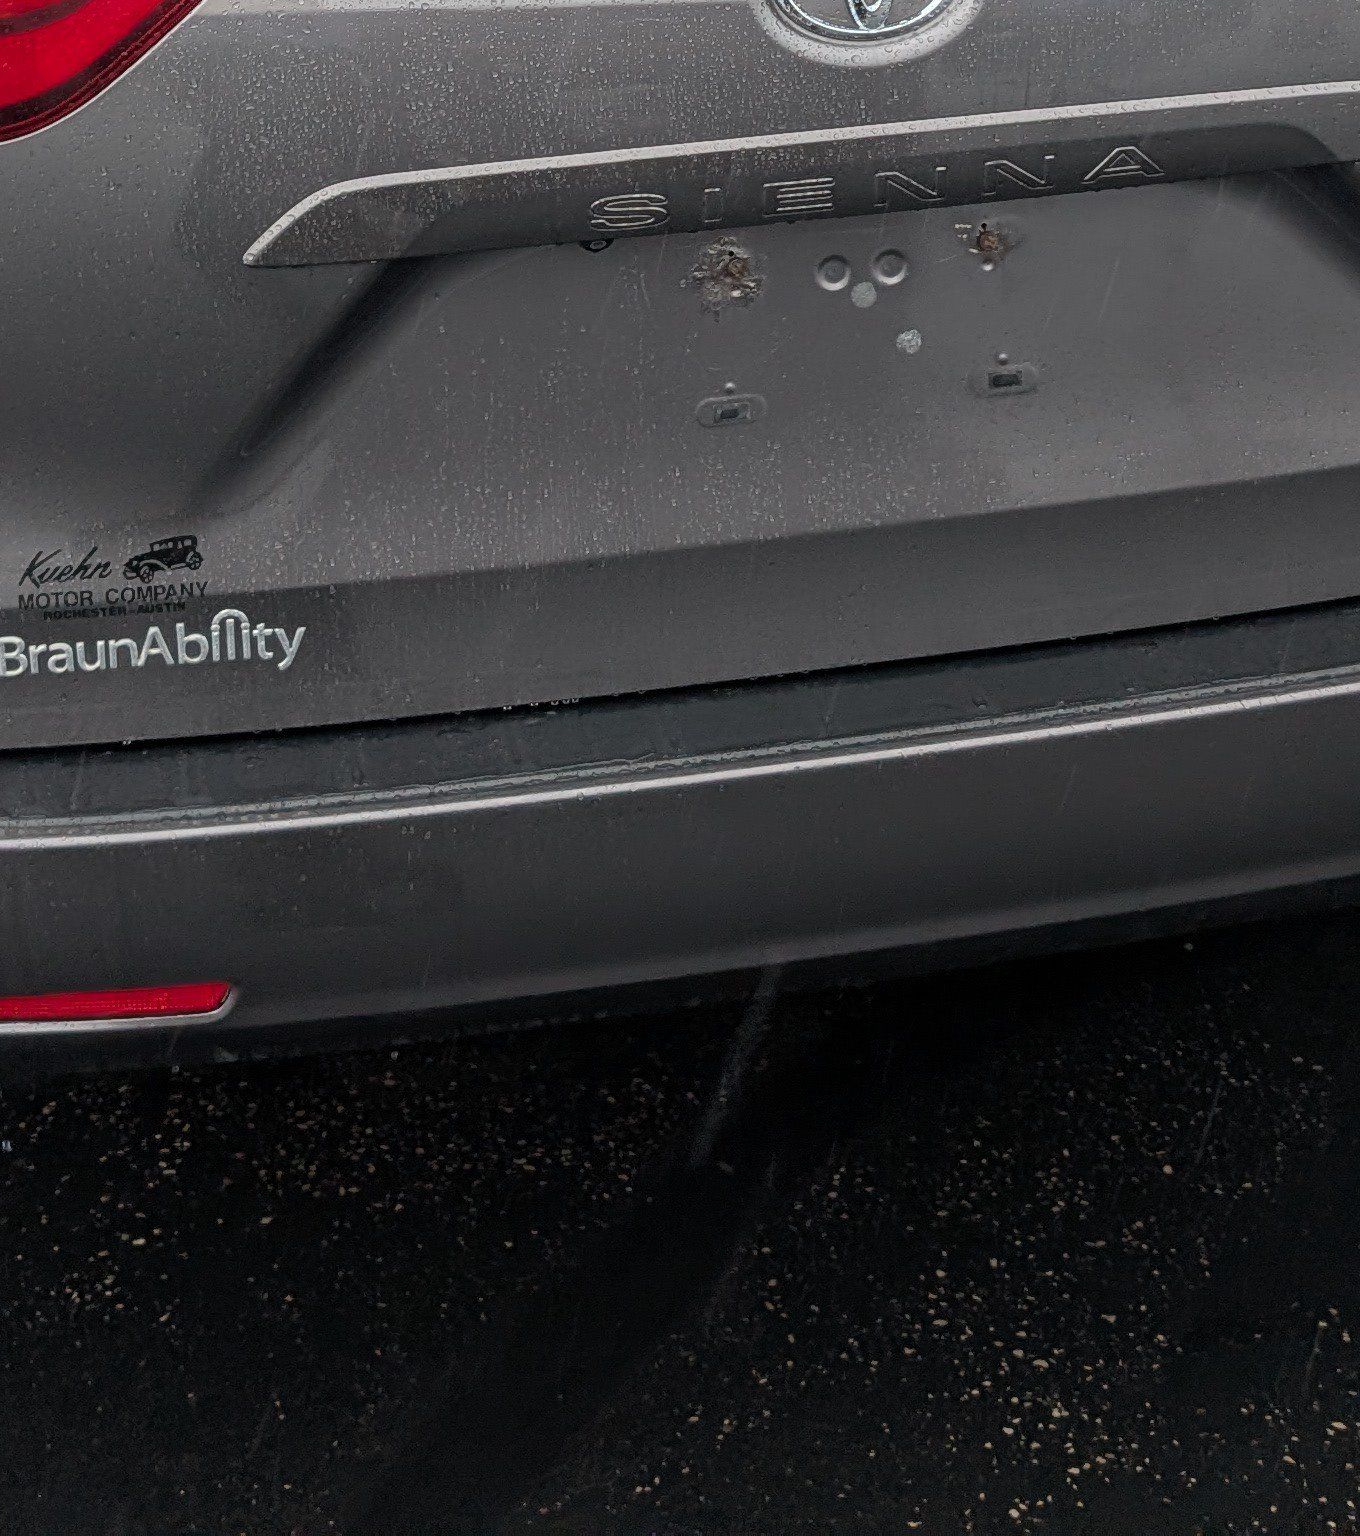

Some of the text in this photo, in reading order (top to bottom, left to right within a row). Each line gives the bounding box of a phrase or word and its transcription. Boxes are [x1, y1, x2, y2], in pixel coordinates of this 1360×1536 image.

[589, 145, 1165, 232] SIENNA
[18, 545, 113, 589] Kuehn
[18, 581, 209, 611] MOTOR COMPANY
